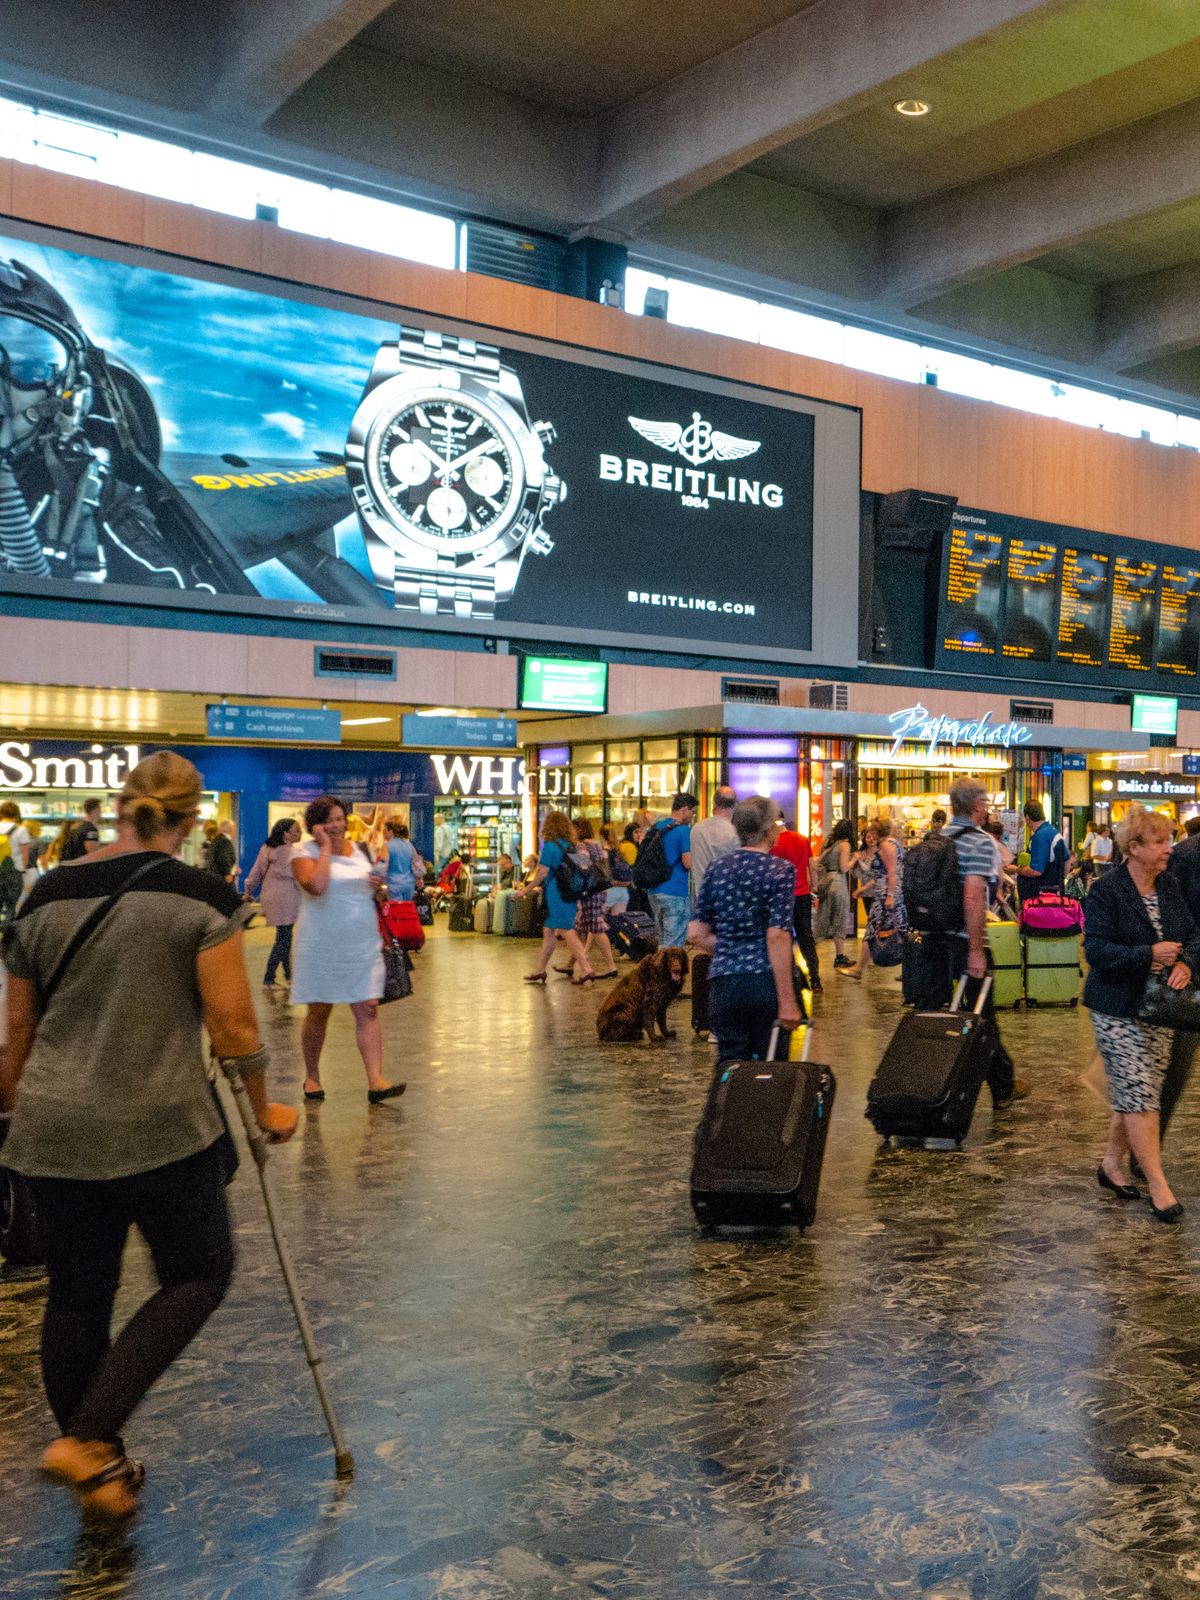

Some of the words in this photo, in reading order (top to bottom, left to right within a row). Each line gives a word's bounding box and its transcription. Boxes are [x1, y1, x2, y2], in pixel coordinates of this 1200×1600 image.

[599, 453, 784, 508] BREITLING
[681, 495, 710, 510] 1884
[952, 511, 987, 525] Departures
[627, 591, 755, 616] BREITLING.COM
[1117, 779, 1149, 794] Delice
[1151, 780, 1162, 793] de
[1164, 782, 1196, 795] France
